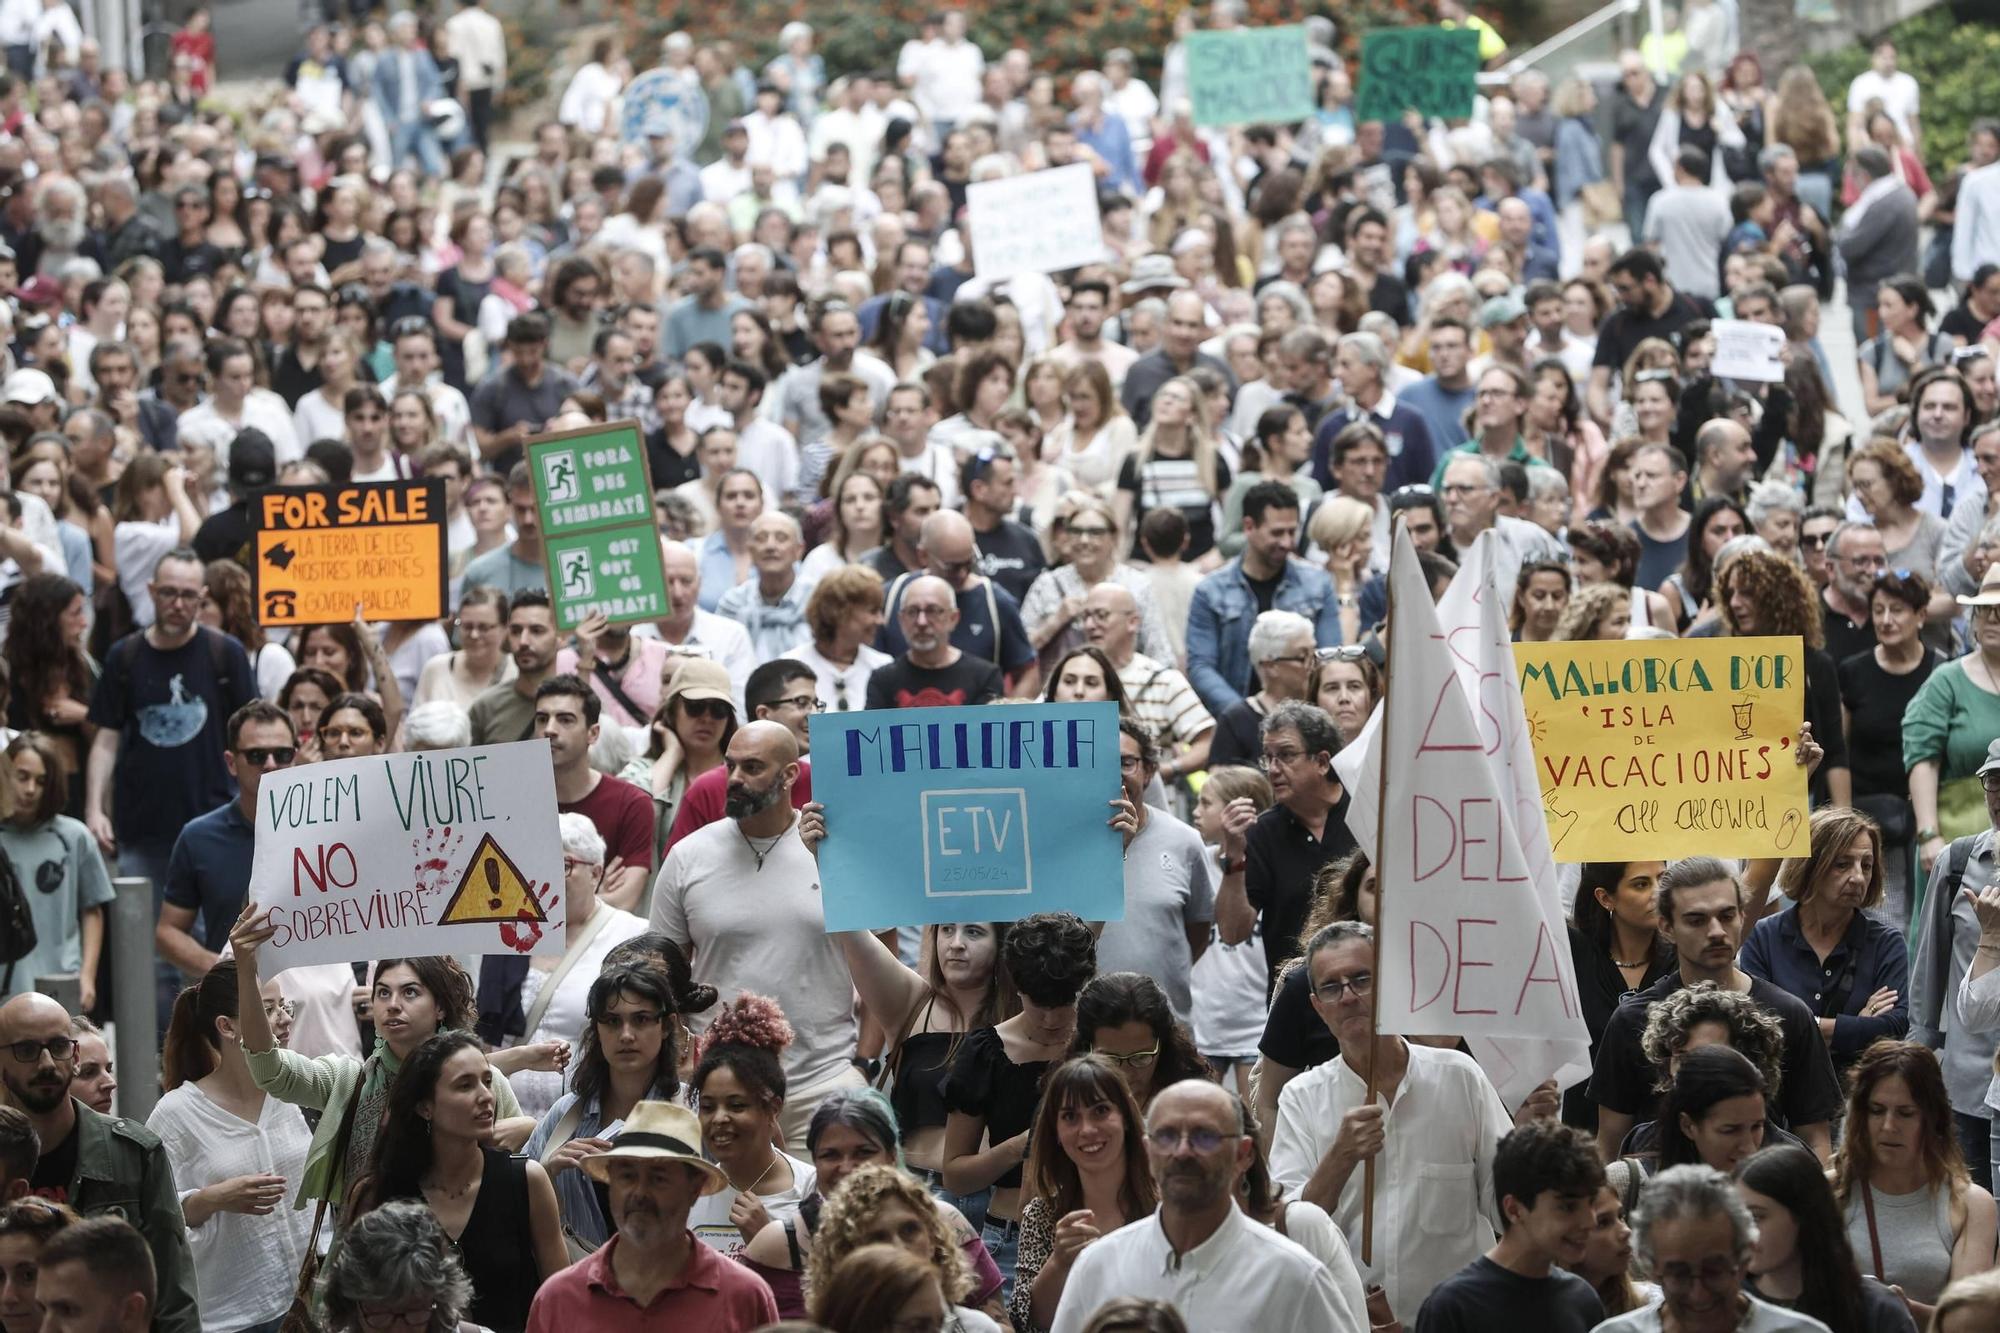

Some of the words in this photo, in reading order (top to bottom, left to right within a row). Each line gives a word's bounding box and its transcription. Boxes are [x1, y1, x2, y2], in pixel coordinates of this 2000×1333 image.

[582, 446, 632, 469] FORA
[592, 473, 626, 493] DES
[263, 492, 330, 529] FOR
[338, 487, 428, 524] SALE
[298, 534, 314, 559] LA
[319, 533, 359, 558] TERRA
[364, 532, 382, 556] DE
[385, 531, 414, 555] LES
[292, 559, 349, 581] NOSTRES
[1520, 657, 1714, 700] MALLORCA
[1730, 654, 1793, 691] D'OR
[845, 718, 1096, 776] MALLORCA
[1634, 734, 1656, 746] DE
[269, 774, 362, 832] VOLEM
[938, 806, 1012, 856] ETV
[293, 842, 358, 897] NO
[941, 866, 1009, 882] 25/05/24
[1411, 918, 1498, 1014] DE
